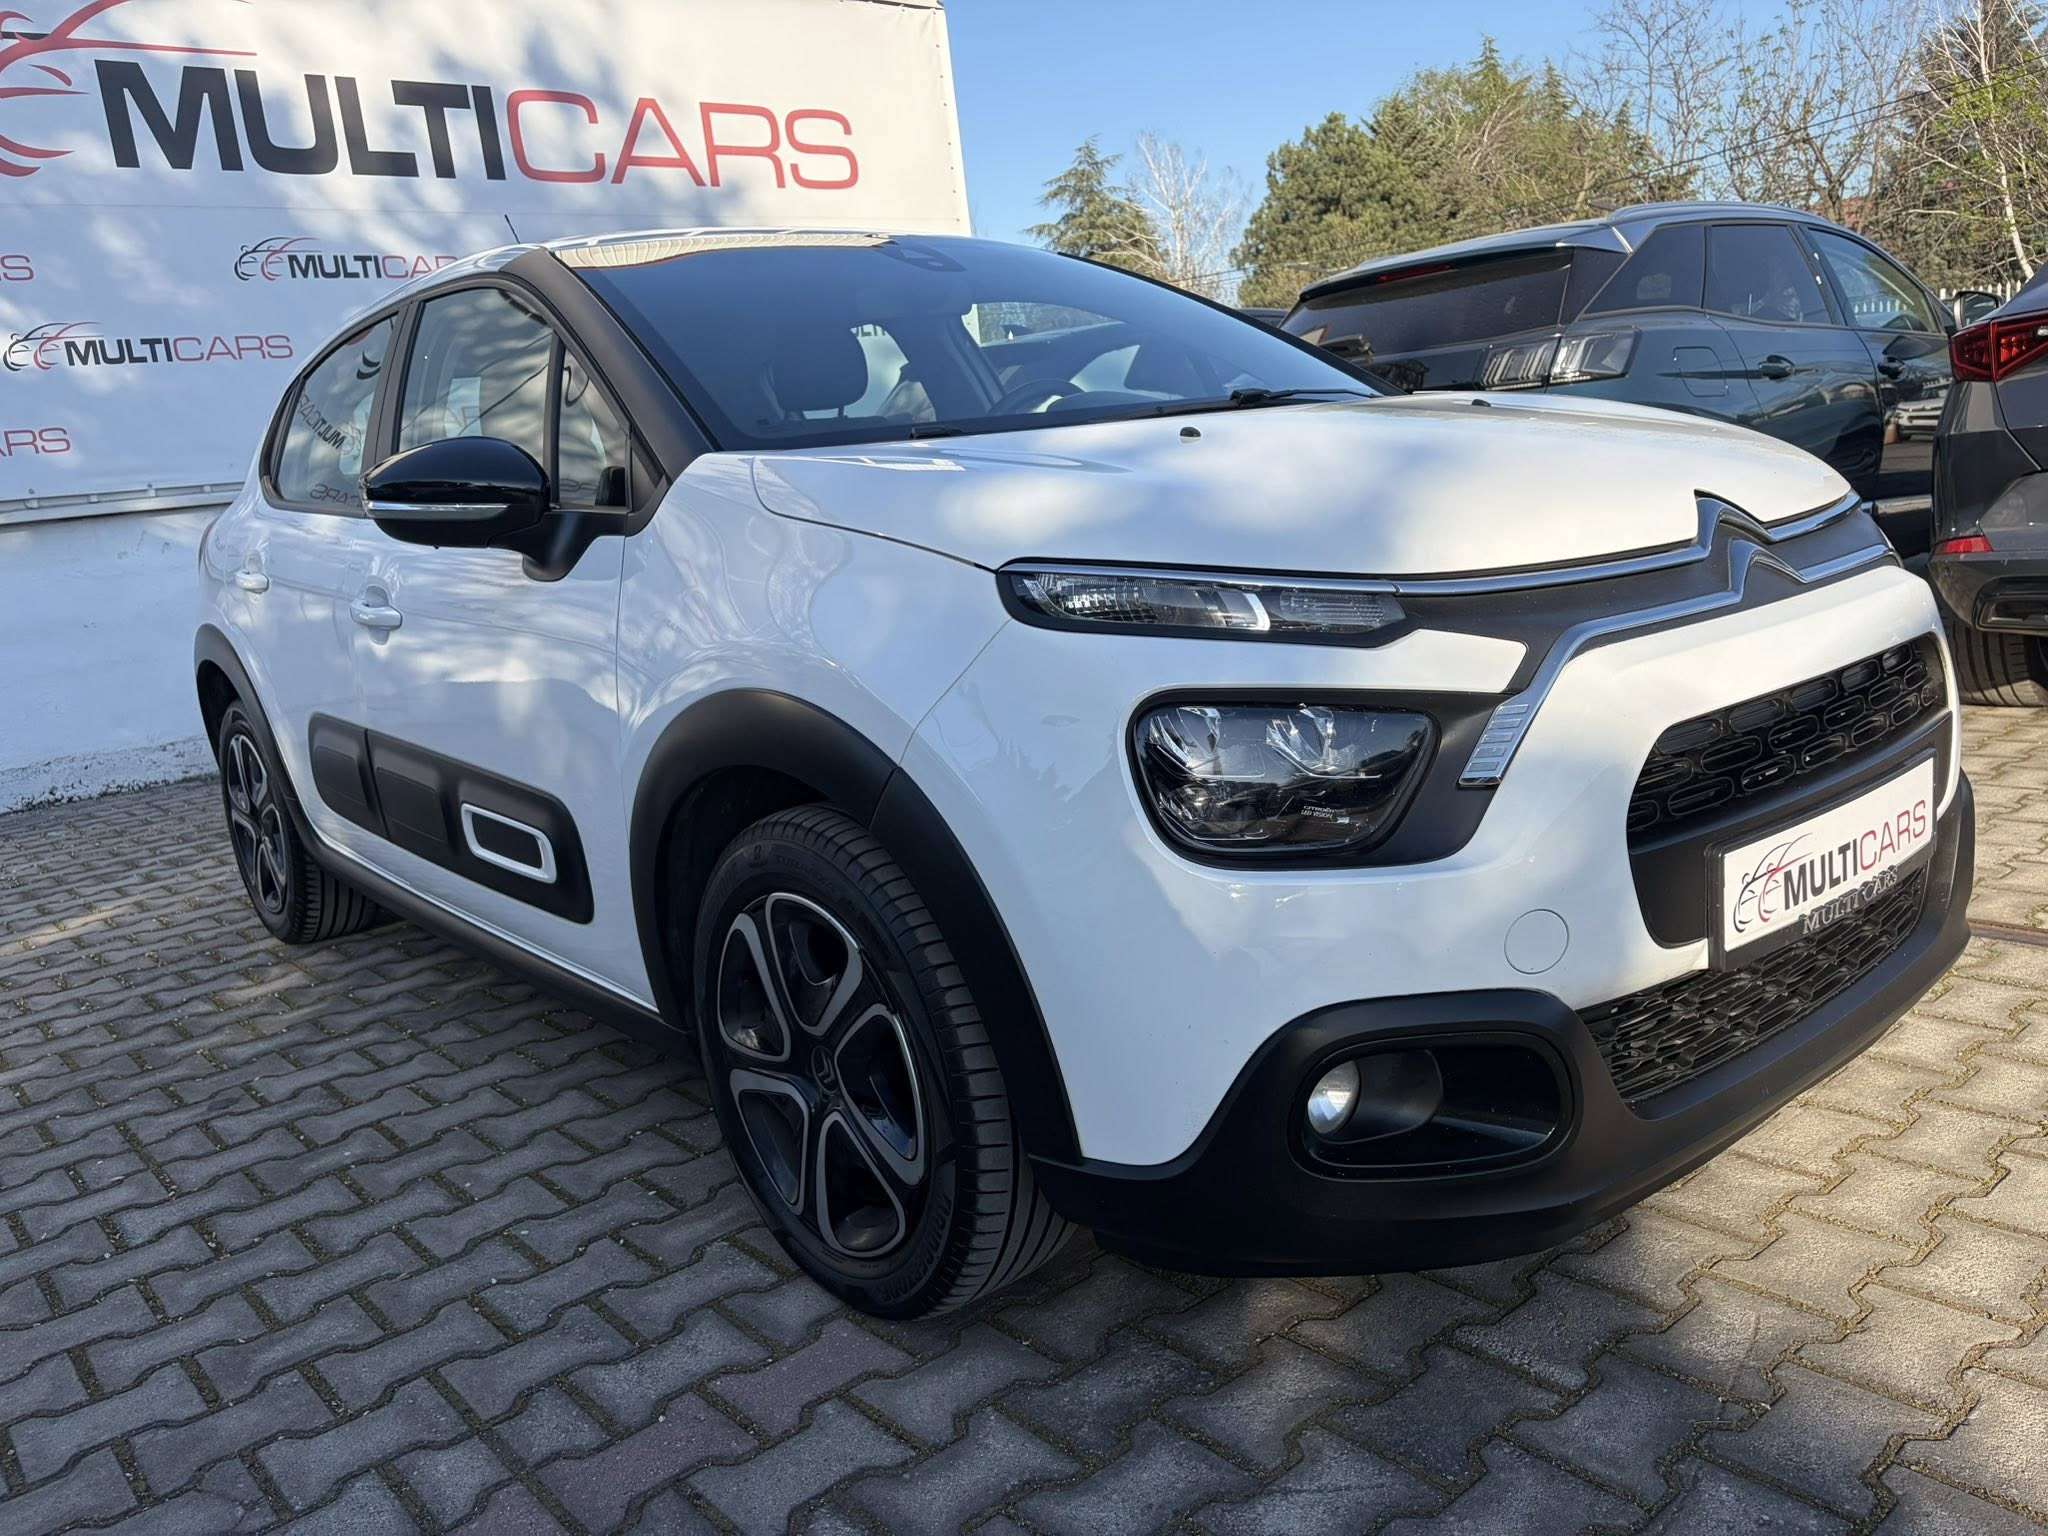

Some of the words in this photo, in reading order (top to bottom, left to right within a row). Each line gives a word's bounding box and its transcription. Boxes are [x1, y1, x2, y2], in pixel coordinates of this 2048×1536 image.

[95, 59, 859, 190] MULTICARS
[64, 335, 294, 367] MULTICARS
[0, 427, 71, 457] RS
[1784, 800, 1926, 910] MULTICARS
[1801, 890, 1860, 935] MULTI
[1862, 867, 1898, 901] CARS
